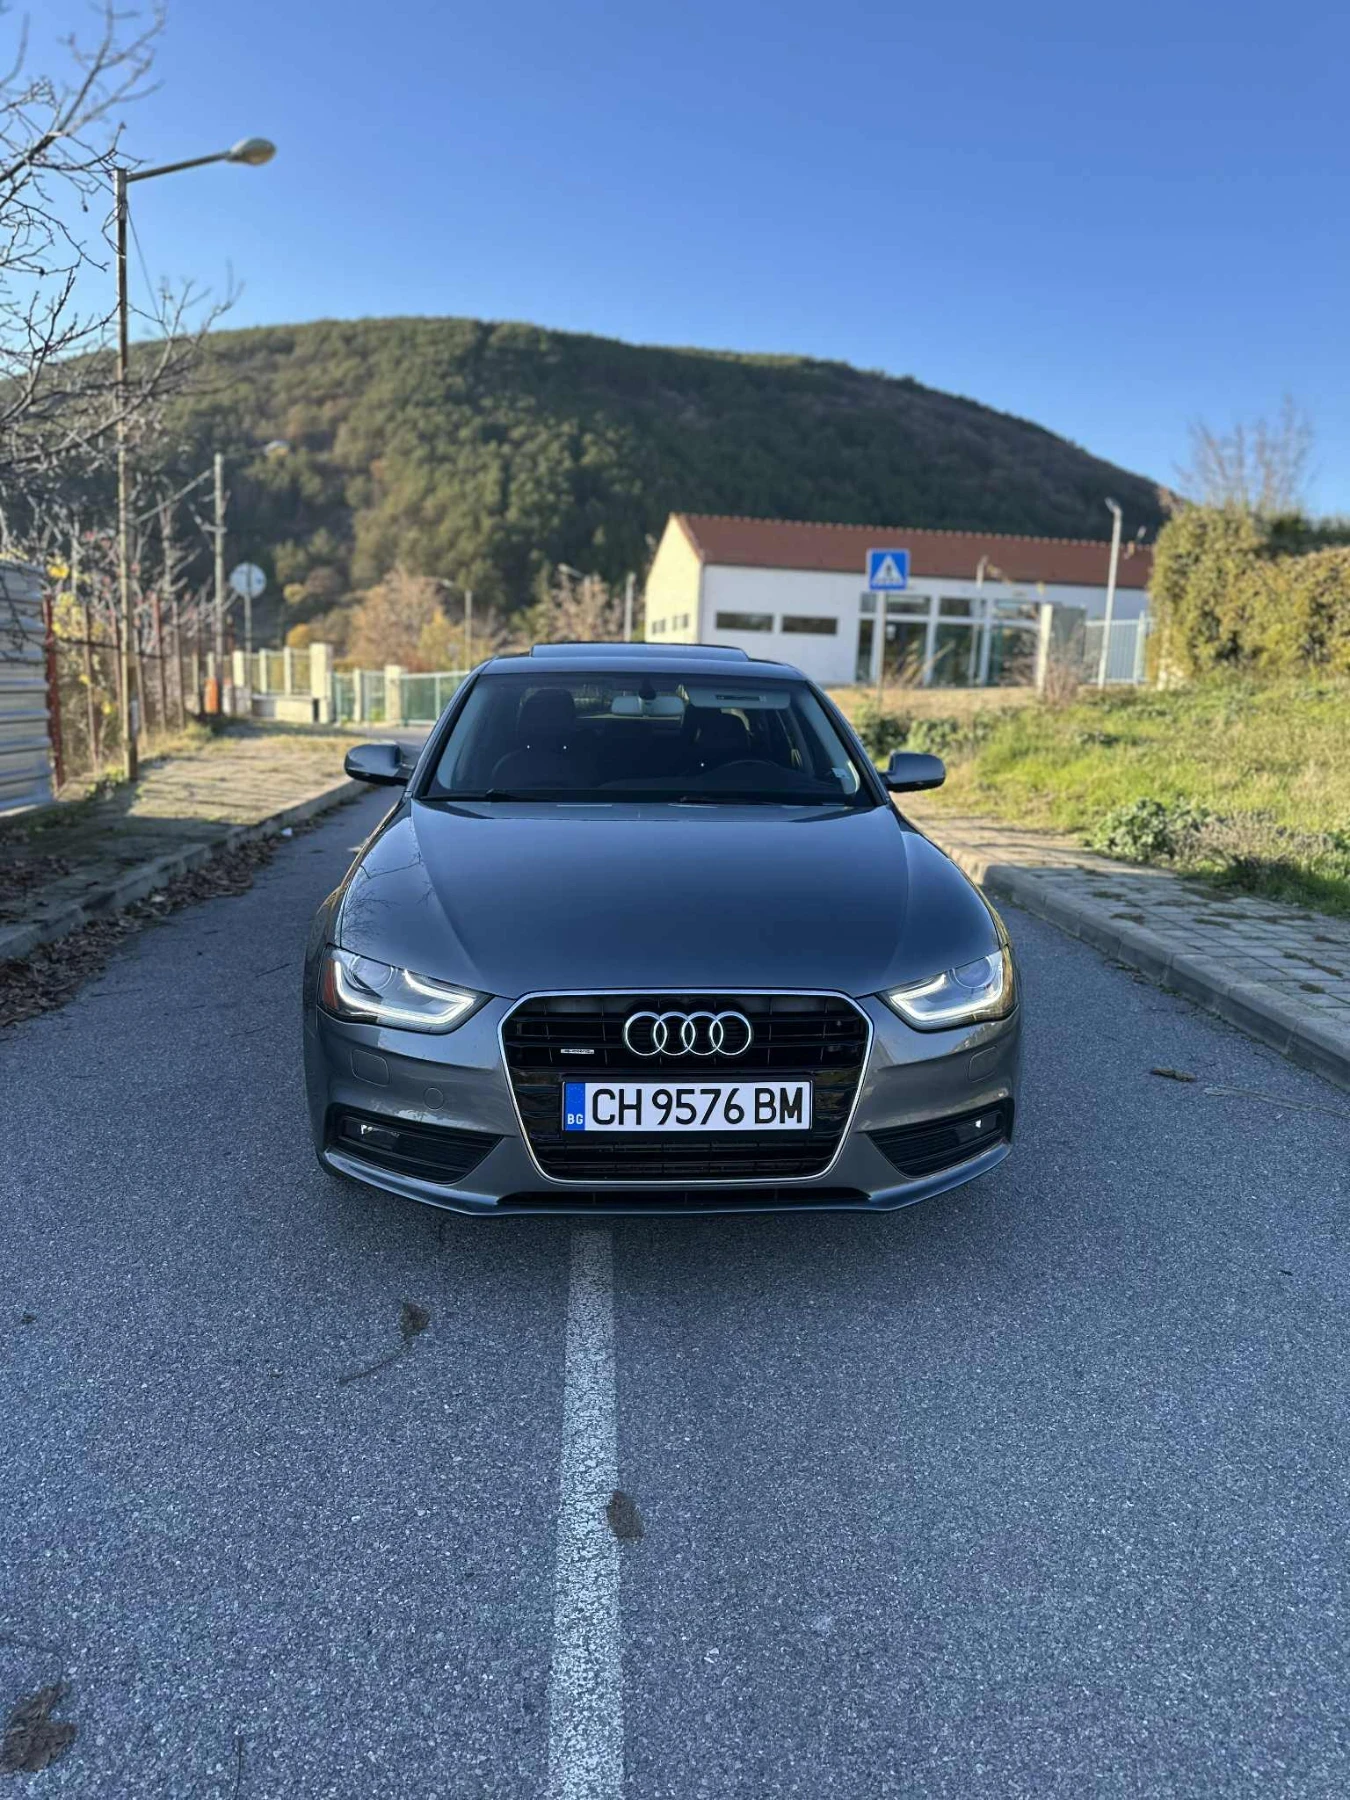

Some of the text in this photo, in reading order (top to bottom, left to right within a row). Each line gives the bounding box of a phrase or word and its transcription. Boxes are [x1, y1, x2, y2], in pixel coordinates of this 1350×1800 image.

[592, 1087, 803, 1125] CH 9576 BM
[567, 1113, 584, 1125] BG
